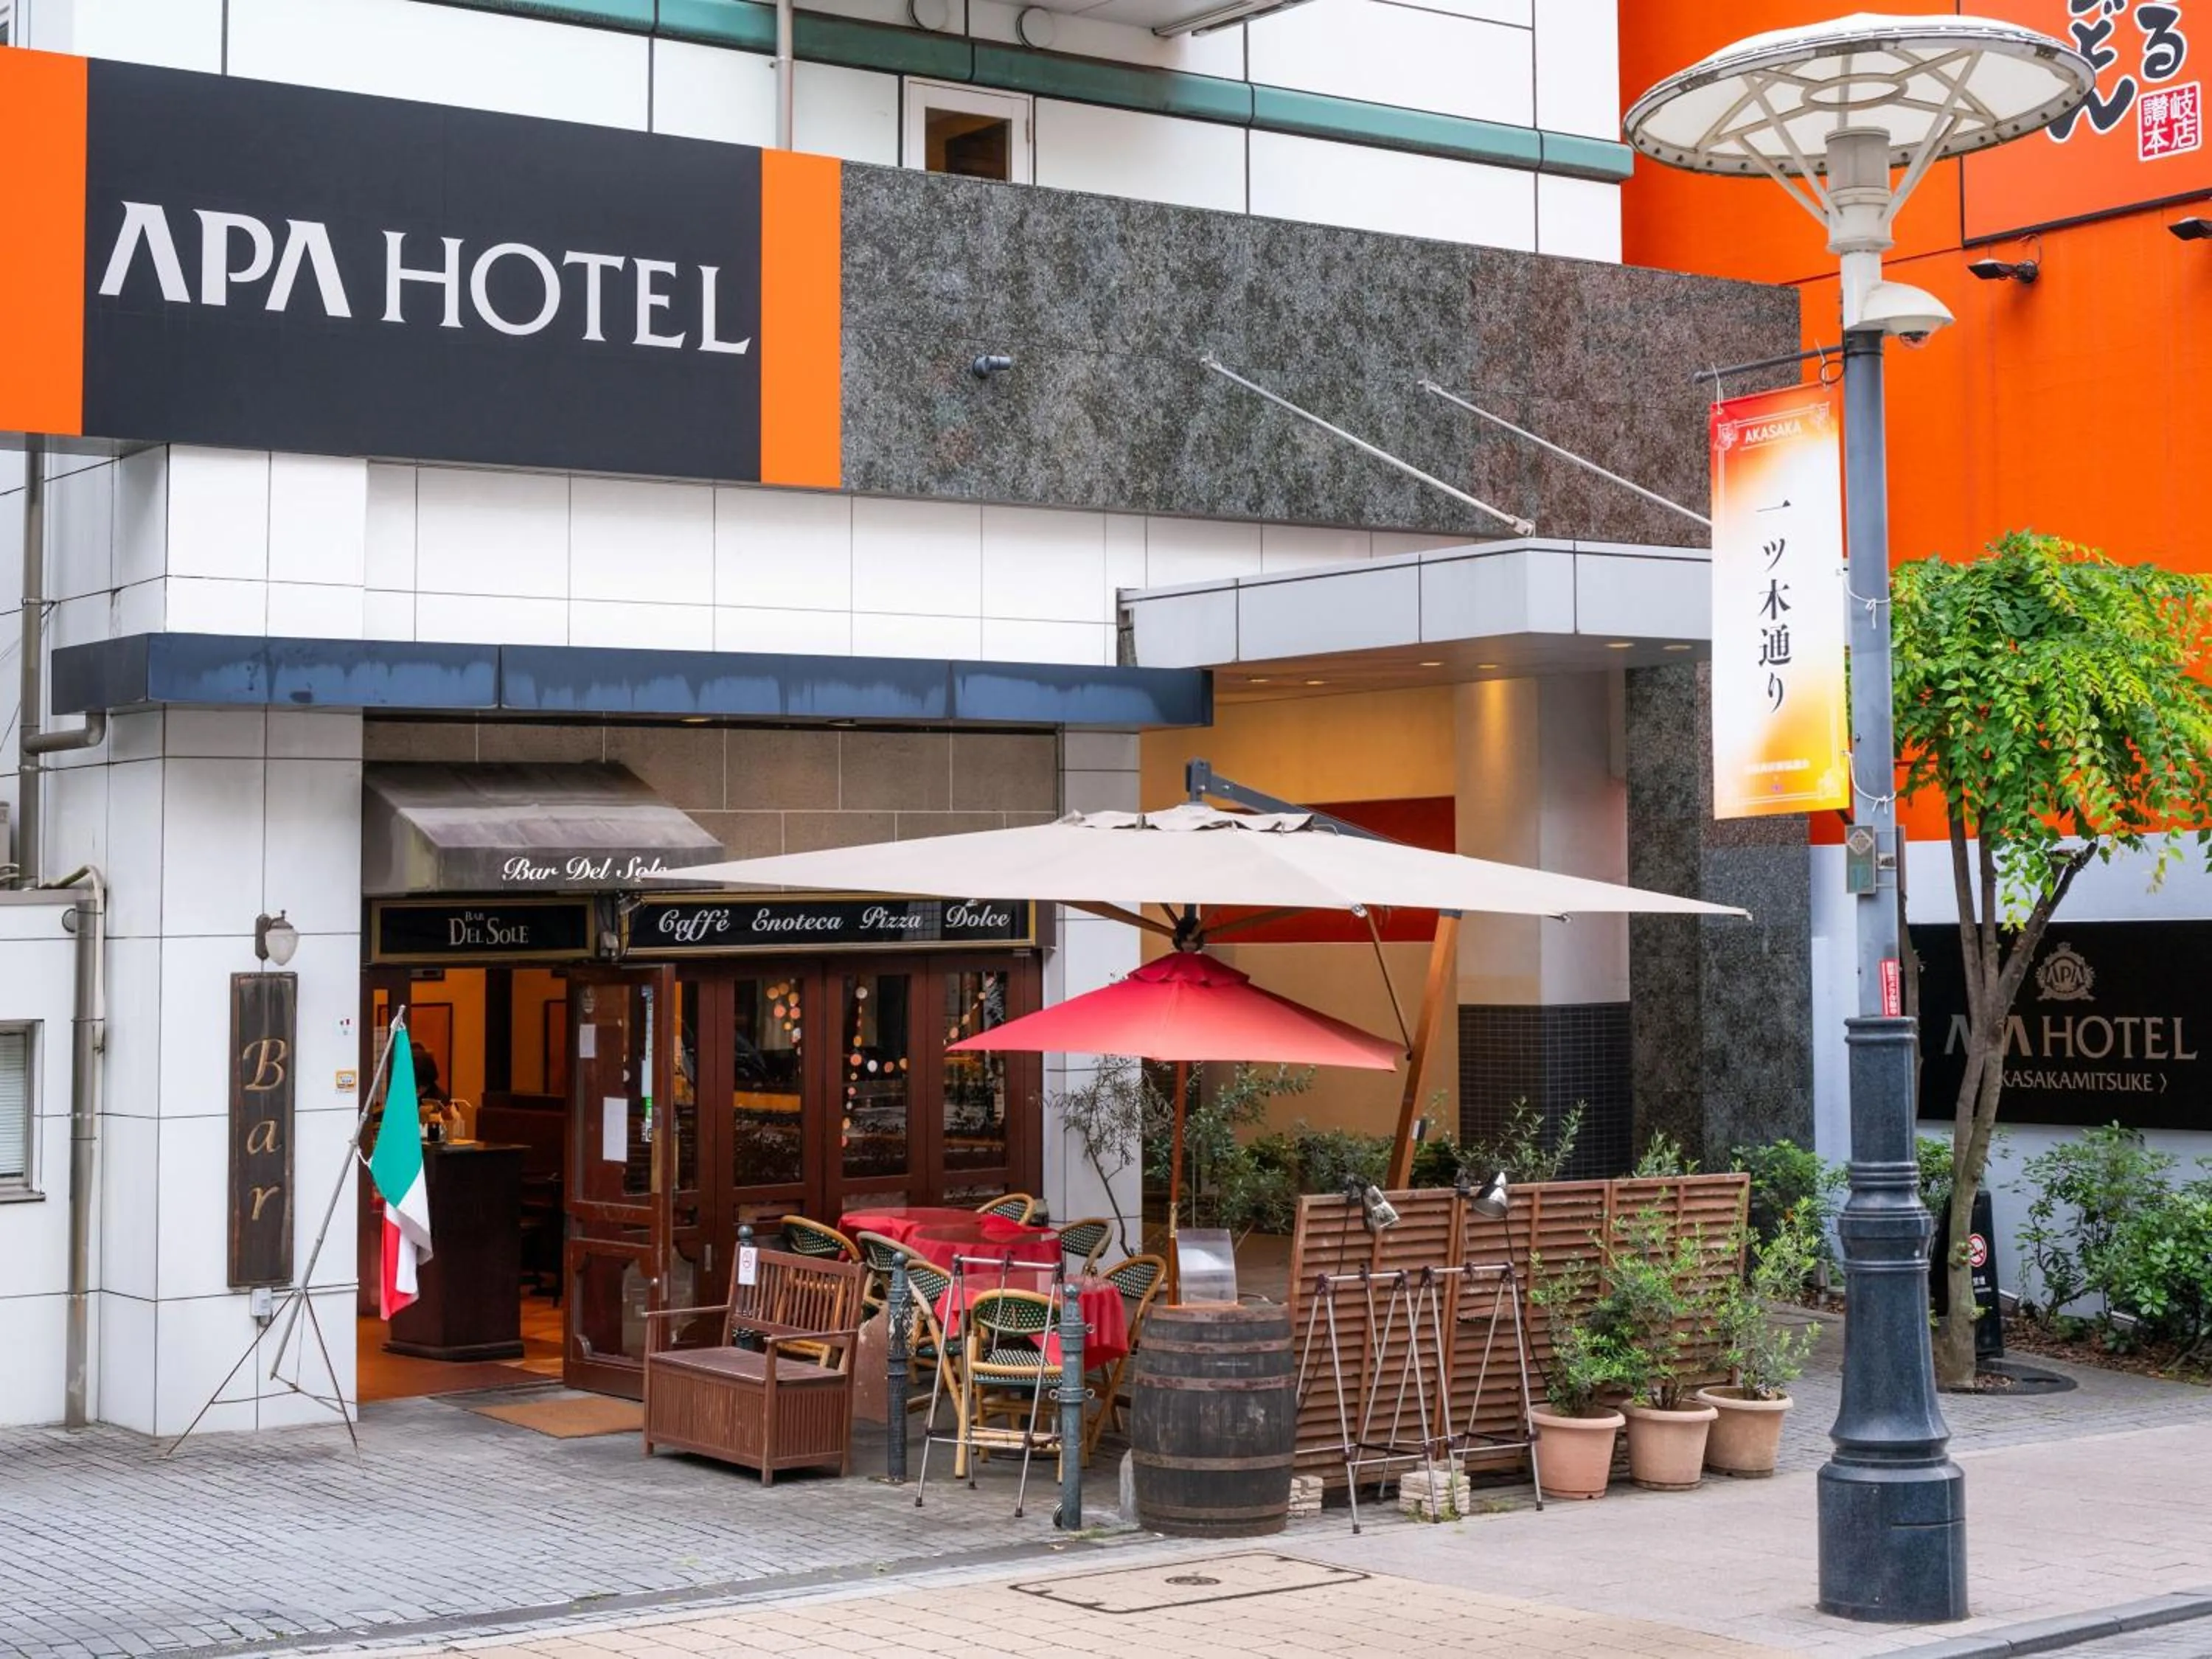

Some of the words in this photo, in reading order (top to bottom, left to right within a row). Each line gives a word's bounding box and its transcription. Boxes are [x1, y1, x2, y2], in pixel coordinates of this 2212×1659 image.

[2045, 0, 2138, 142] どん
[98, 200, 352, 319] APA
[380, 229, 751, 355] HOTEL
[1745, 419, 1802, 443] AKASAKA
[1756, 499, 1792, 714] 一ツ木通り
[501, 856, 559, 881] Bar
[566, 856, 613, 881] Del
[751, 907, 844, 932] Enoteca
[859, 905, 923, 930] Pizza
[945, 900, 1011, 928] Dolce
[1944, 1014, 2033, 1057] AA
[2042, 1015, 2199, 1061] HOTEL
[242, 1037, 288, 1221] Bar
